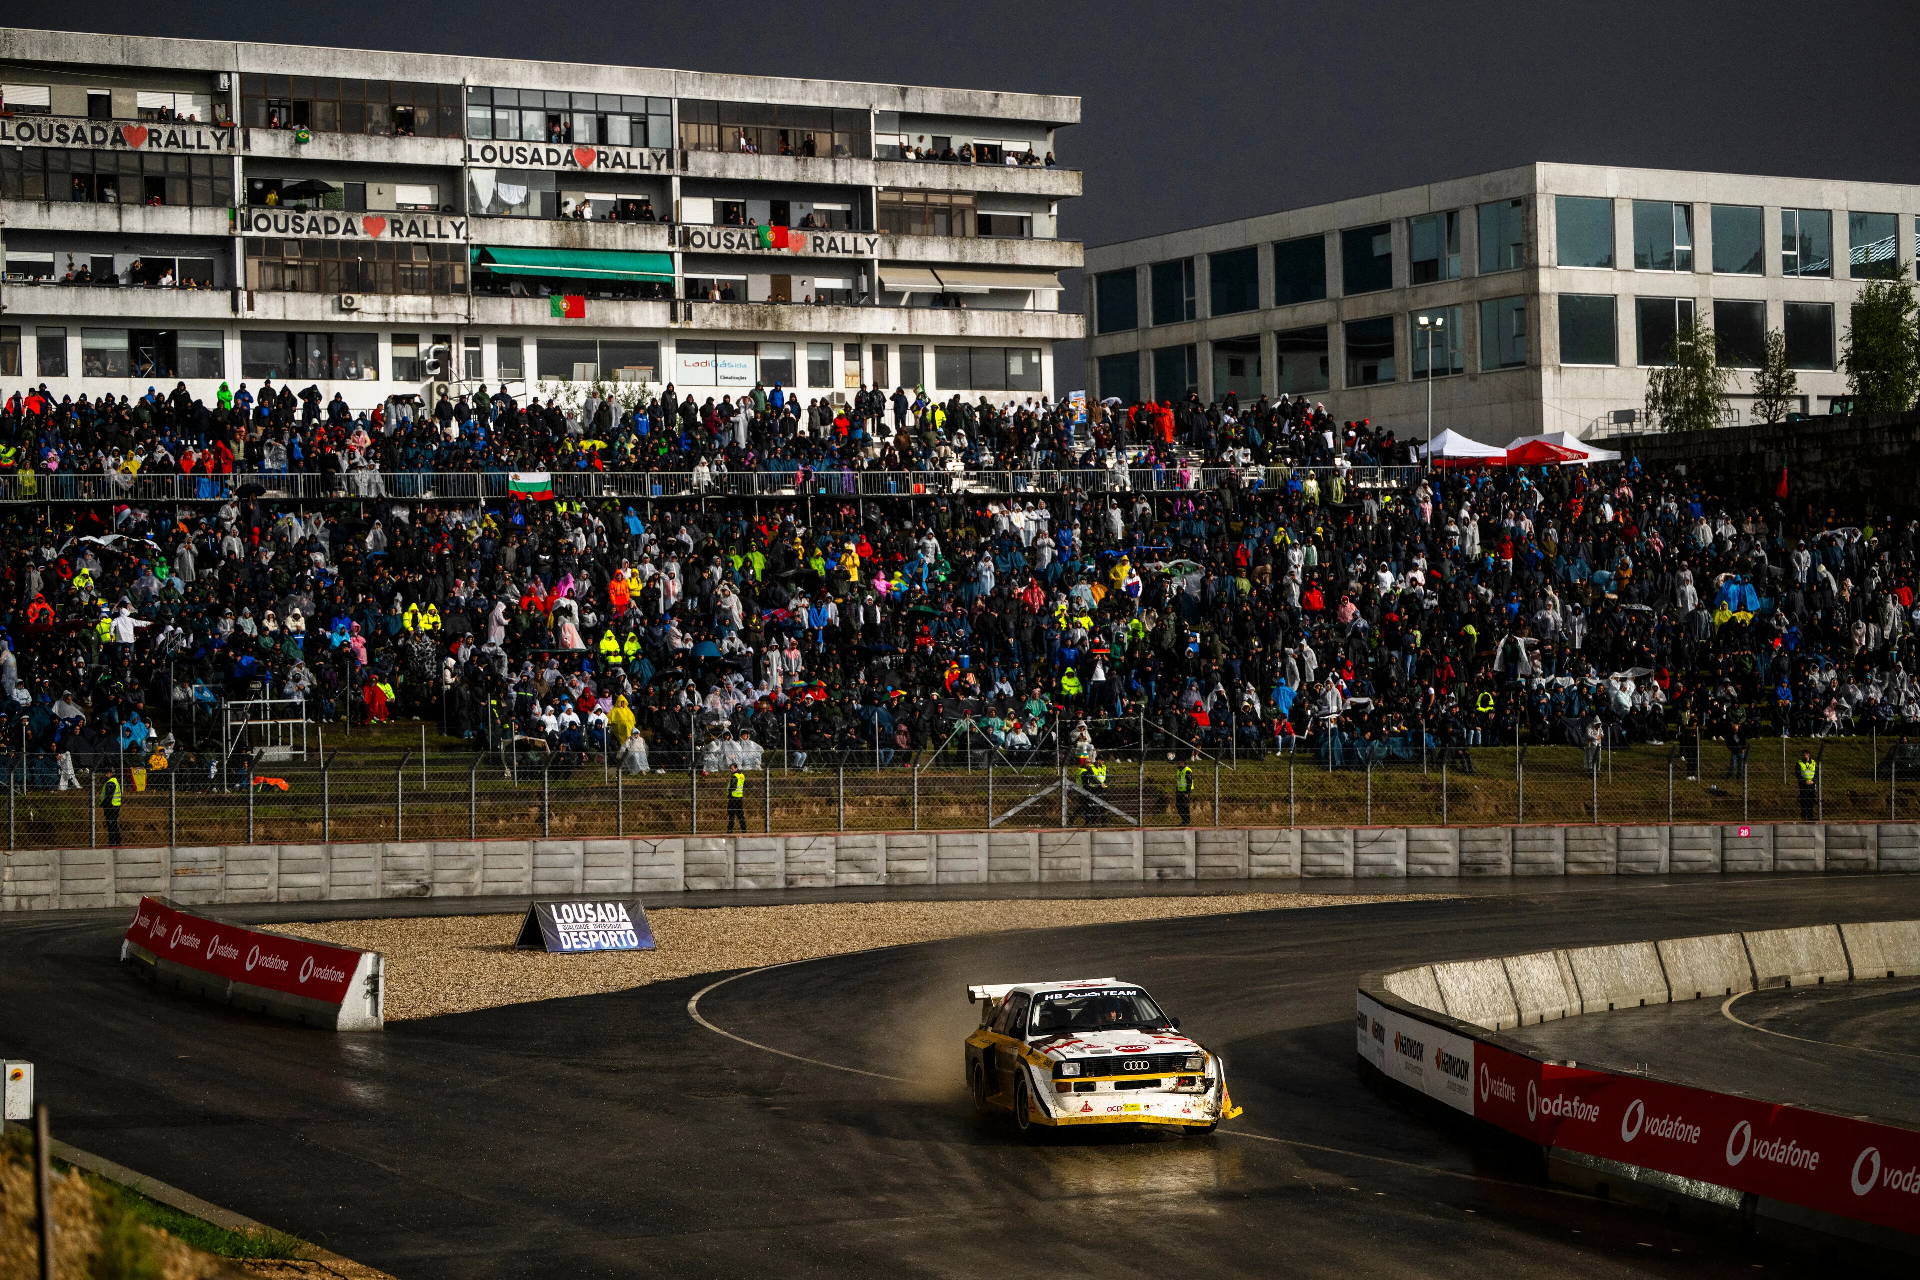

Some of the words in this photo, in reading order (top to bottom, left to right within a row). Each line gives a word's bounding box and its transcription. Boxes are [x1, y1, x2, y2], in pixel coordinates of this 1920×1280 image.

[0, 121, 127, 147] LOUSADA
[147, 128, 228, 151] RALLY
[467, 143, 578, 168] LOUSADA
[596, 150, 666, 171] RALLY
[240, 212, 359, 236] LOUSADA
[390, 218, 466, 240] RALLY
[812, 236, 879, 255] RALLY
[551, 902, 631, 924] LOUSADA
[559, 929, 639, 950] DESPORTO
[258, 953, 289, 971] vodafone
[312, 965, 345, 983] vodafone
[1489, 1075, 1516, 1104] vodafone
[1644, 1114, 1701, 1145] vodafone
[1752, 1137, 1820, 1171] vodafone
